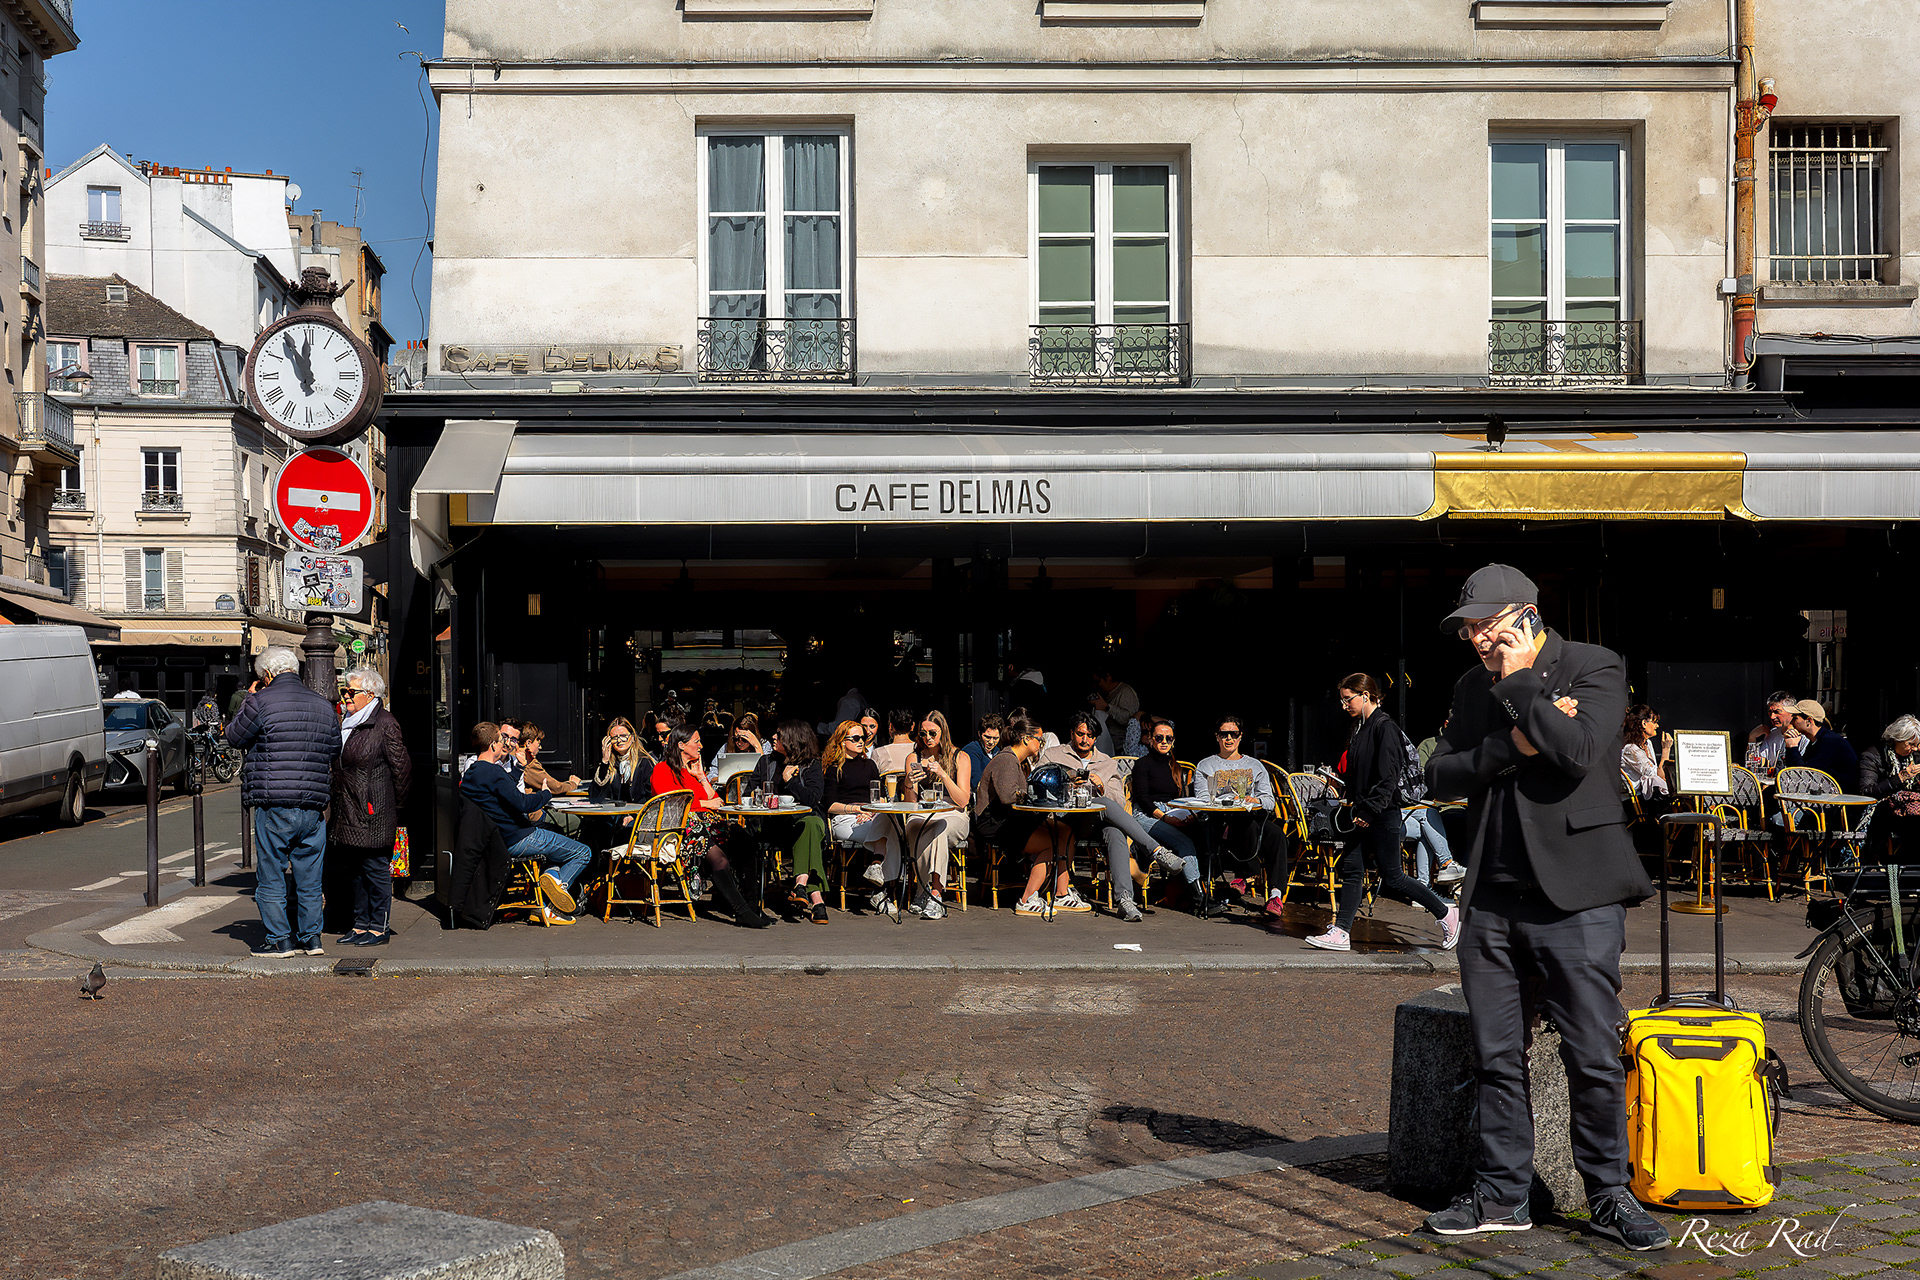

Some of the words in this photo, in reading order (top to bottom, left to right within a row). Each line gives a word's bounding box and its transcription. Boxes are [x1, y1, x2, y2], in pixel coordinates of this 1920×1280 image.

[543, 345, 681, 371] DELMAS
[835, 483, 930, 512] CAFE
[939, 479, 1052, 514] DELMAS
